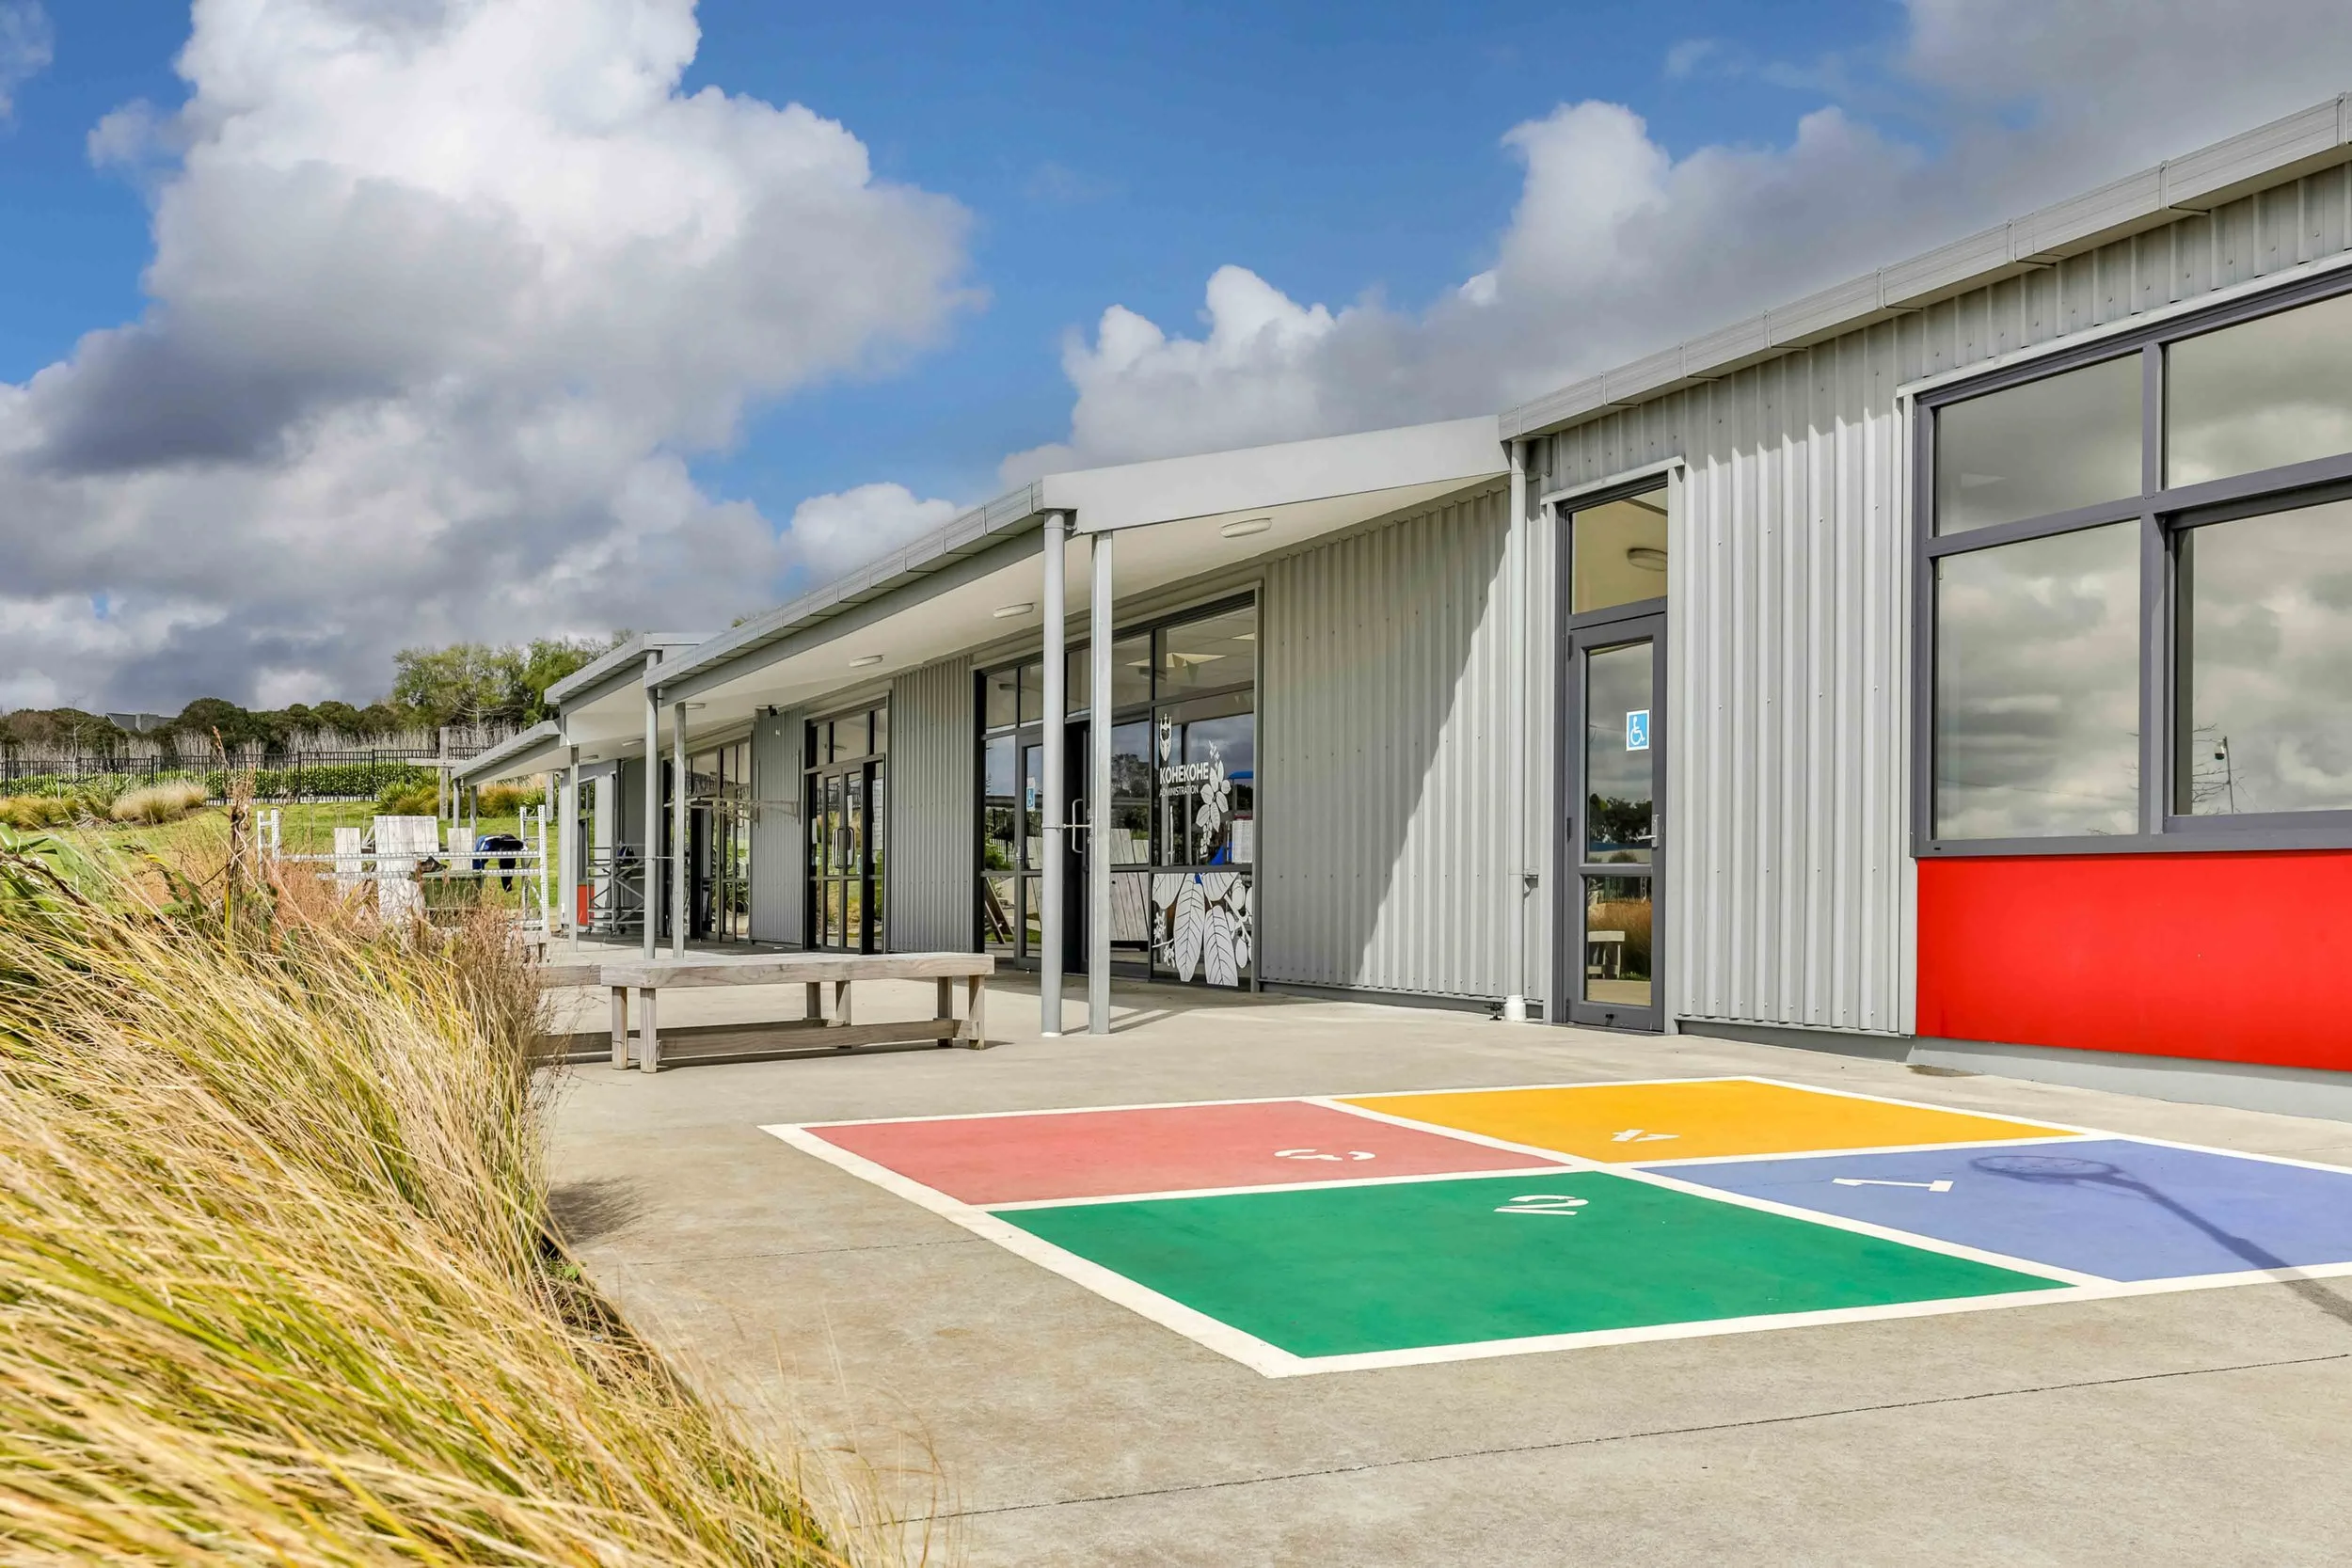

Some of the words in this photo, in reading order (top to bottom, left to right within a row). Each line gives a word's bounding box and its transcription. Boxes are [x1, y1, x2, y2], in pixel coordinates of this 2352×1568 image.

[1159, 762, 1209, 784] KOHEKOHE
[1159, 784, 1200, 798] ADMINISTRATION
[1610, 1128, 1680, 1143] 4
[1832, 1178, 1954, 1193] 1
[1492, 1194, 1589, 1216] 2
